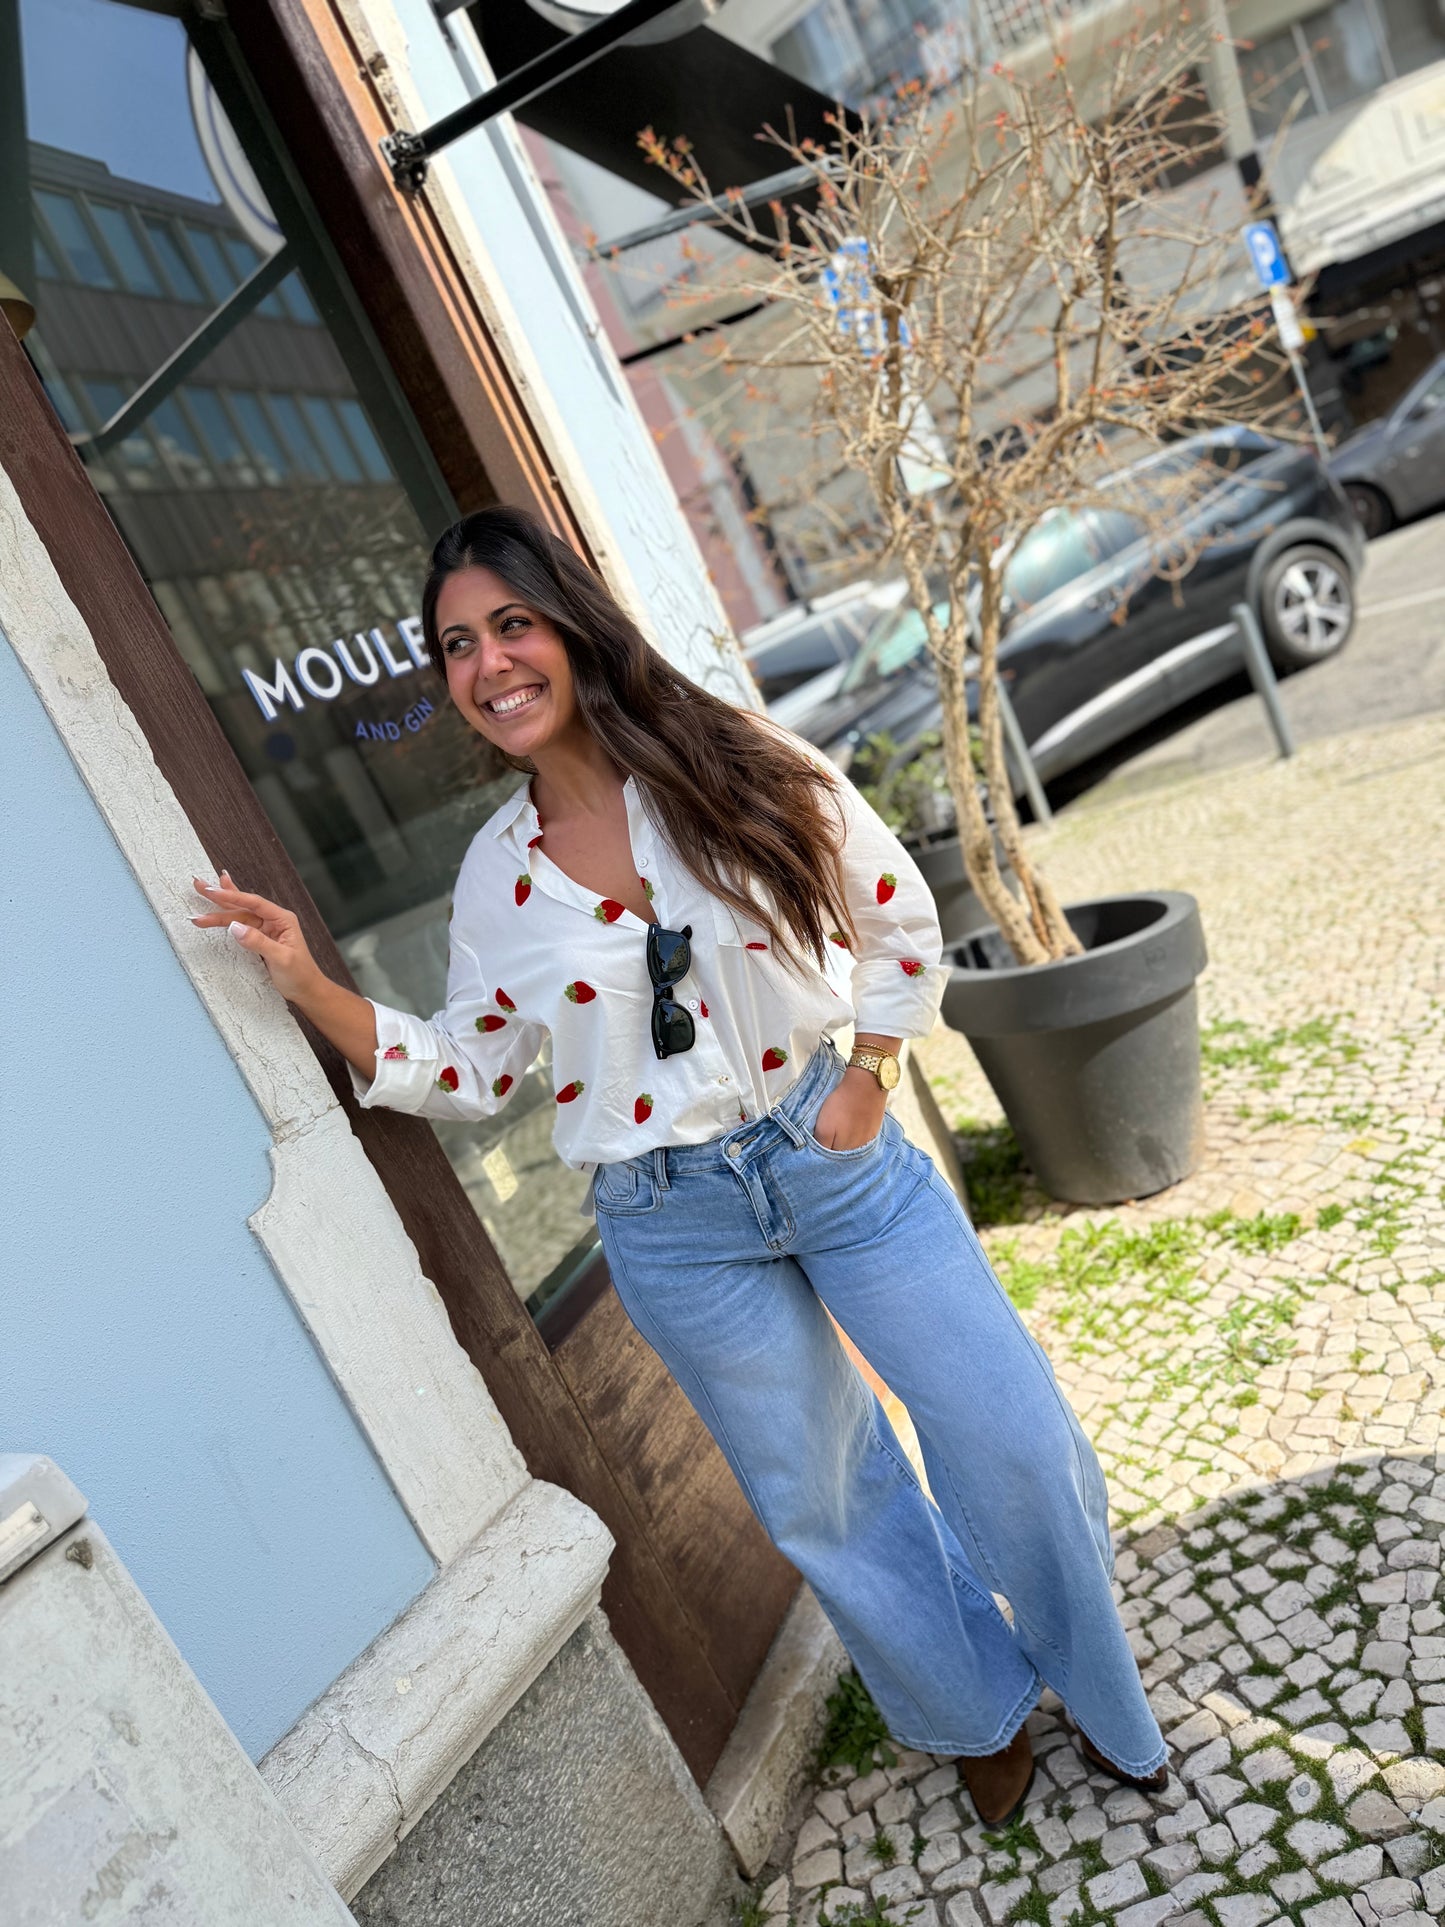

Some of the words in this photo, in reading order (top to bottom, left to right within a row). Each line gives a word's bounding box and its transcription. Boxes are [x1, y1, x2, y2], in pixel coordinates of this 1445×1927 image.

[1250, 230, 1276, 281] P
[356, 720, 400, 741] AND
[404, 697, 434, 732] GIN
